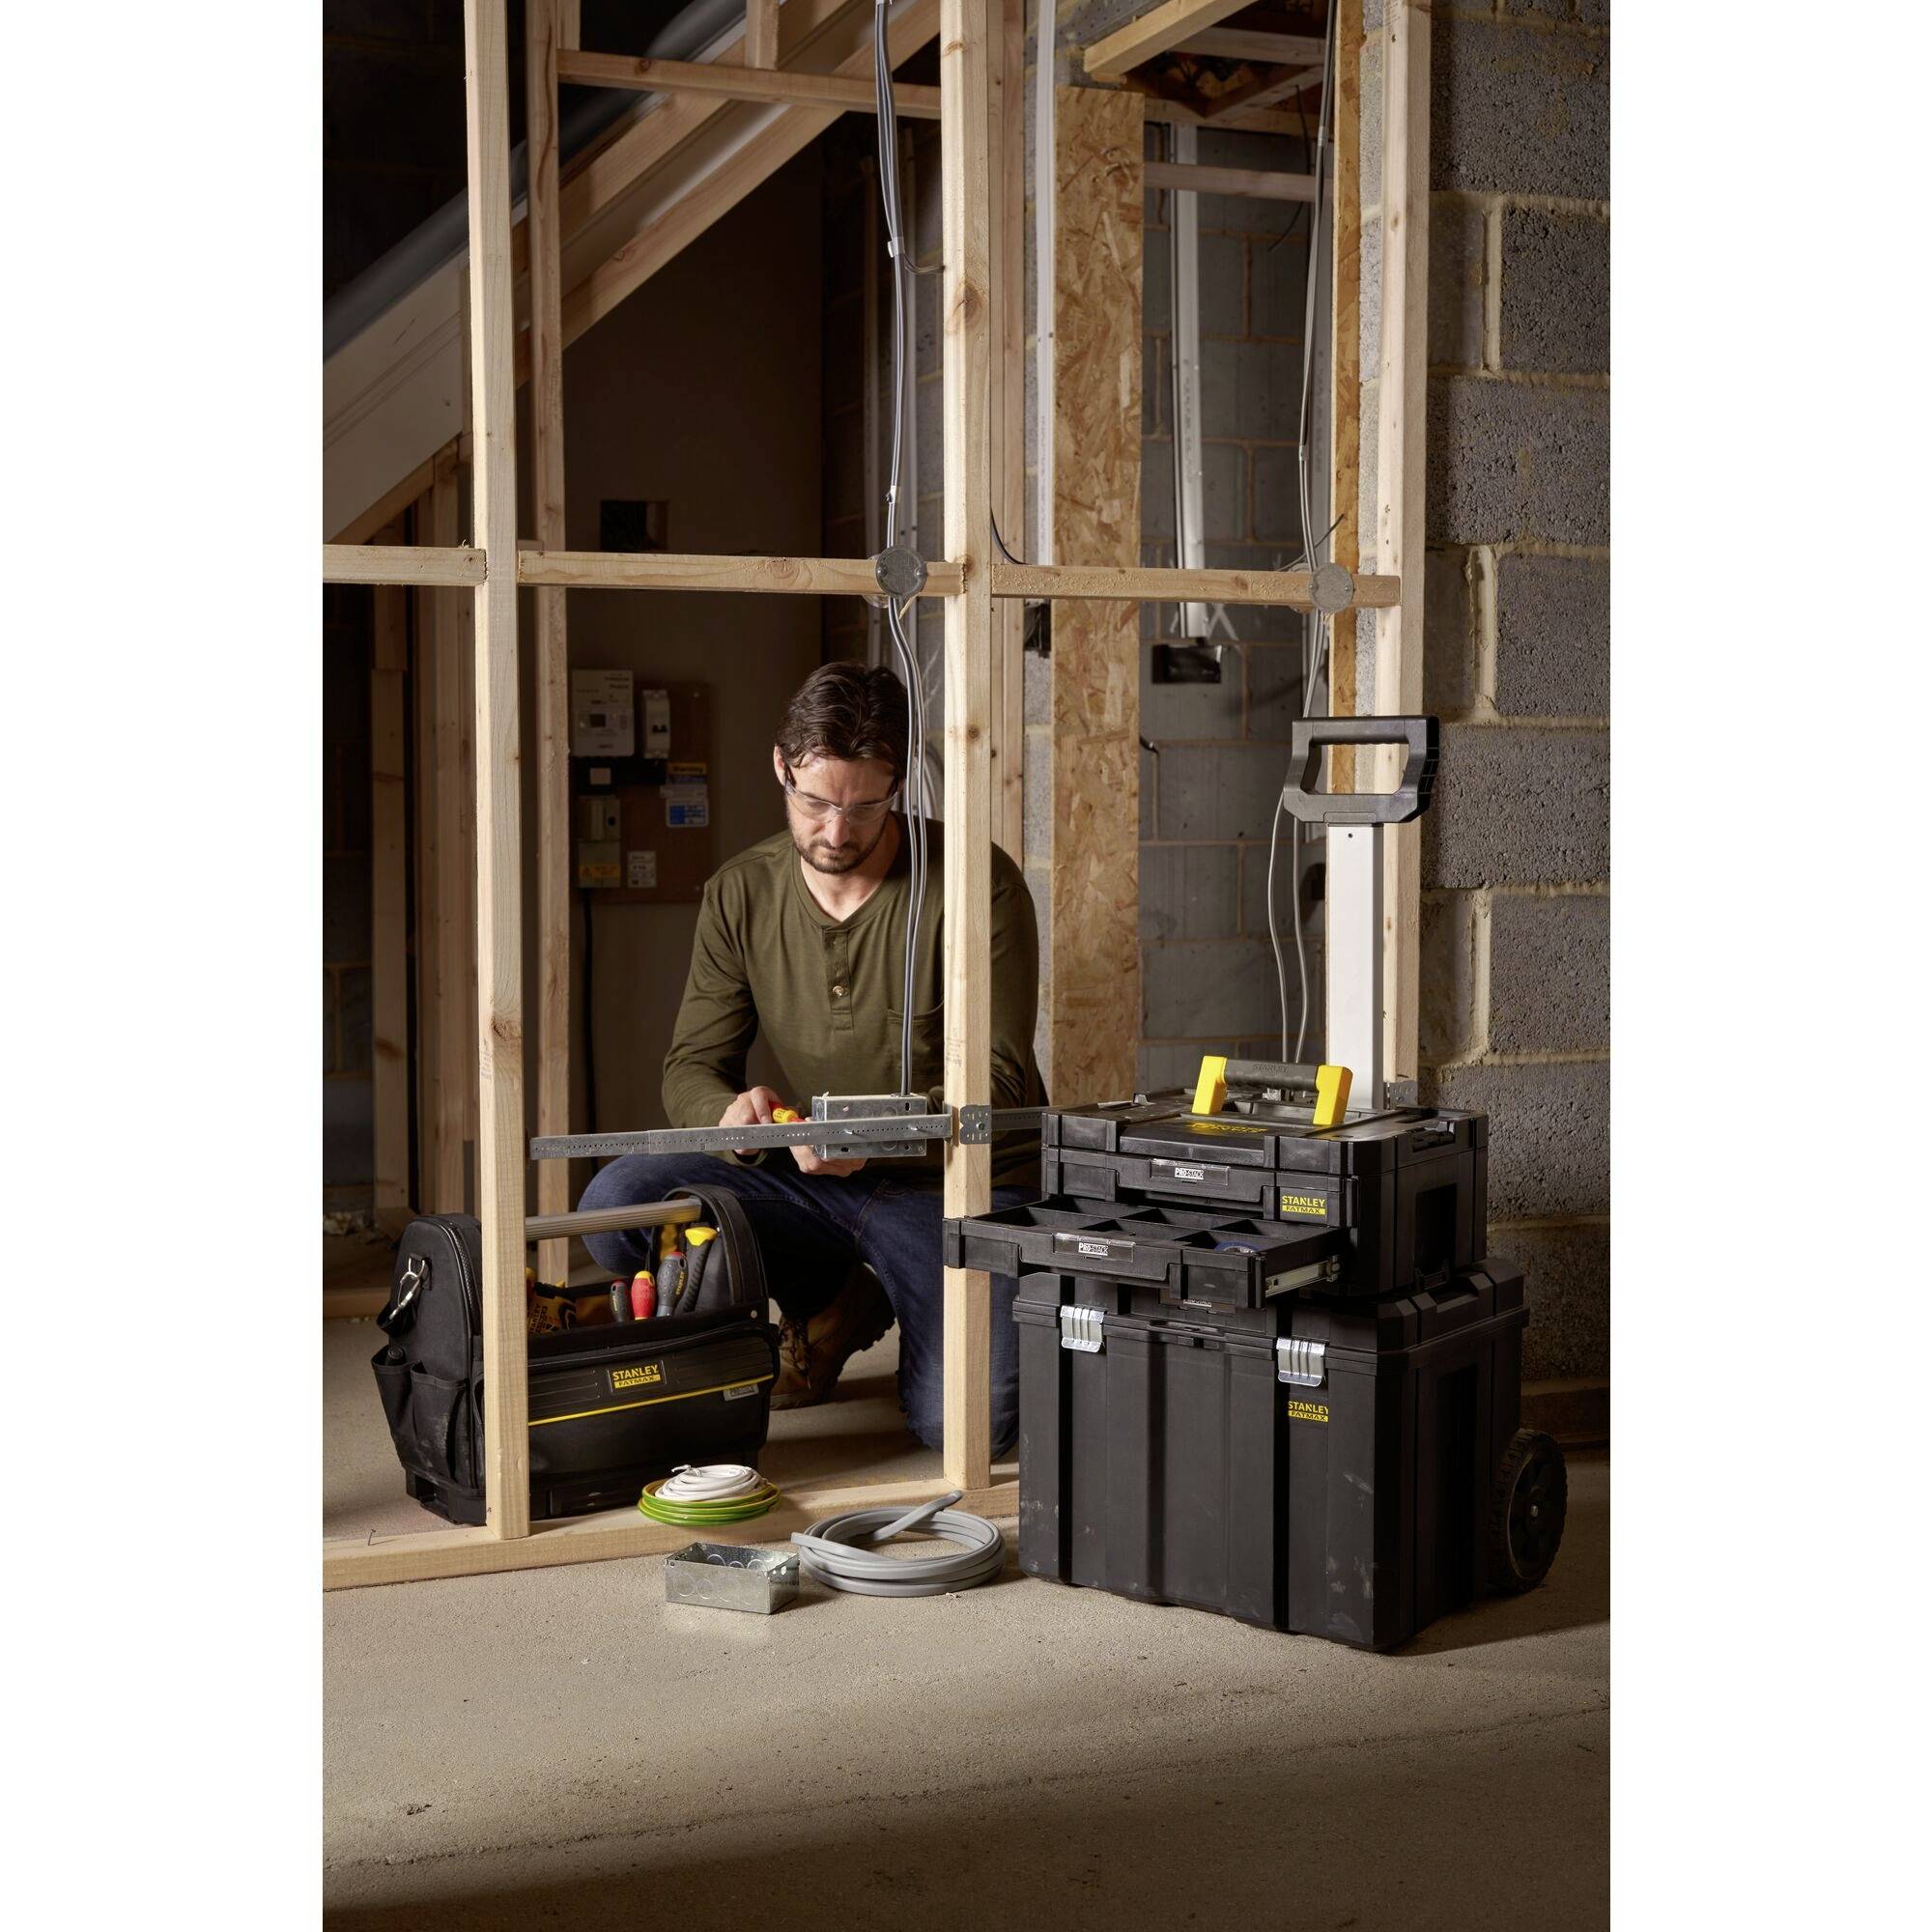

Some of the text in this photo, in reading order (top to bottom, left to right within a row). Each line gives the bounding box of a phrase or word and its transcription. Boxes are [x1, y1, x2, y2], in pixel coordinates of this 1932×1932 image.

[1282, 1195, 1325, 1207] STANLEY
[1285, 1206, 1323, 1214] FATMAX
[612, 1364, 659, 1381] STANLEY
[616, 1375, 658, 1387] FATMAX
[1288, 1401, 1329, 1414] STANLEY
[1290, 1410, 1326, 1421] FATMAX
